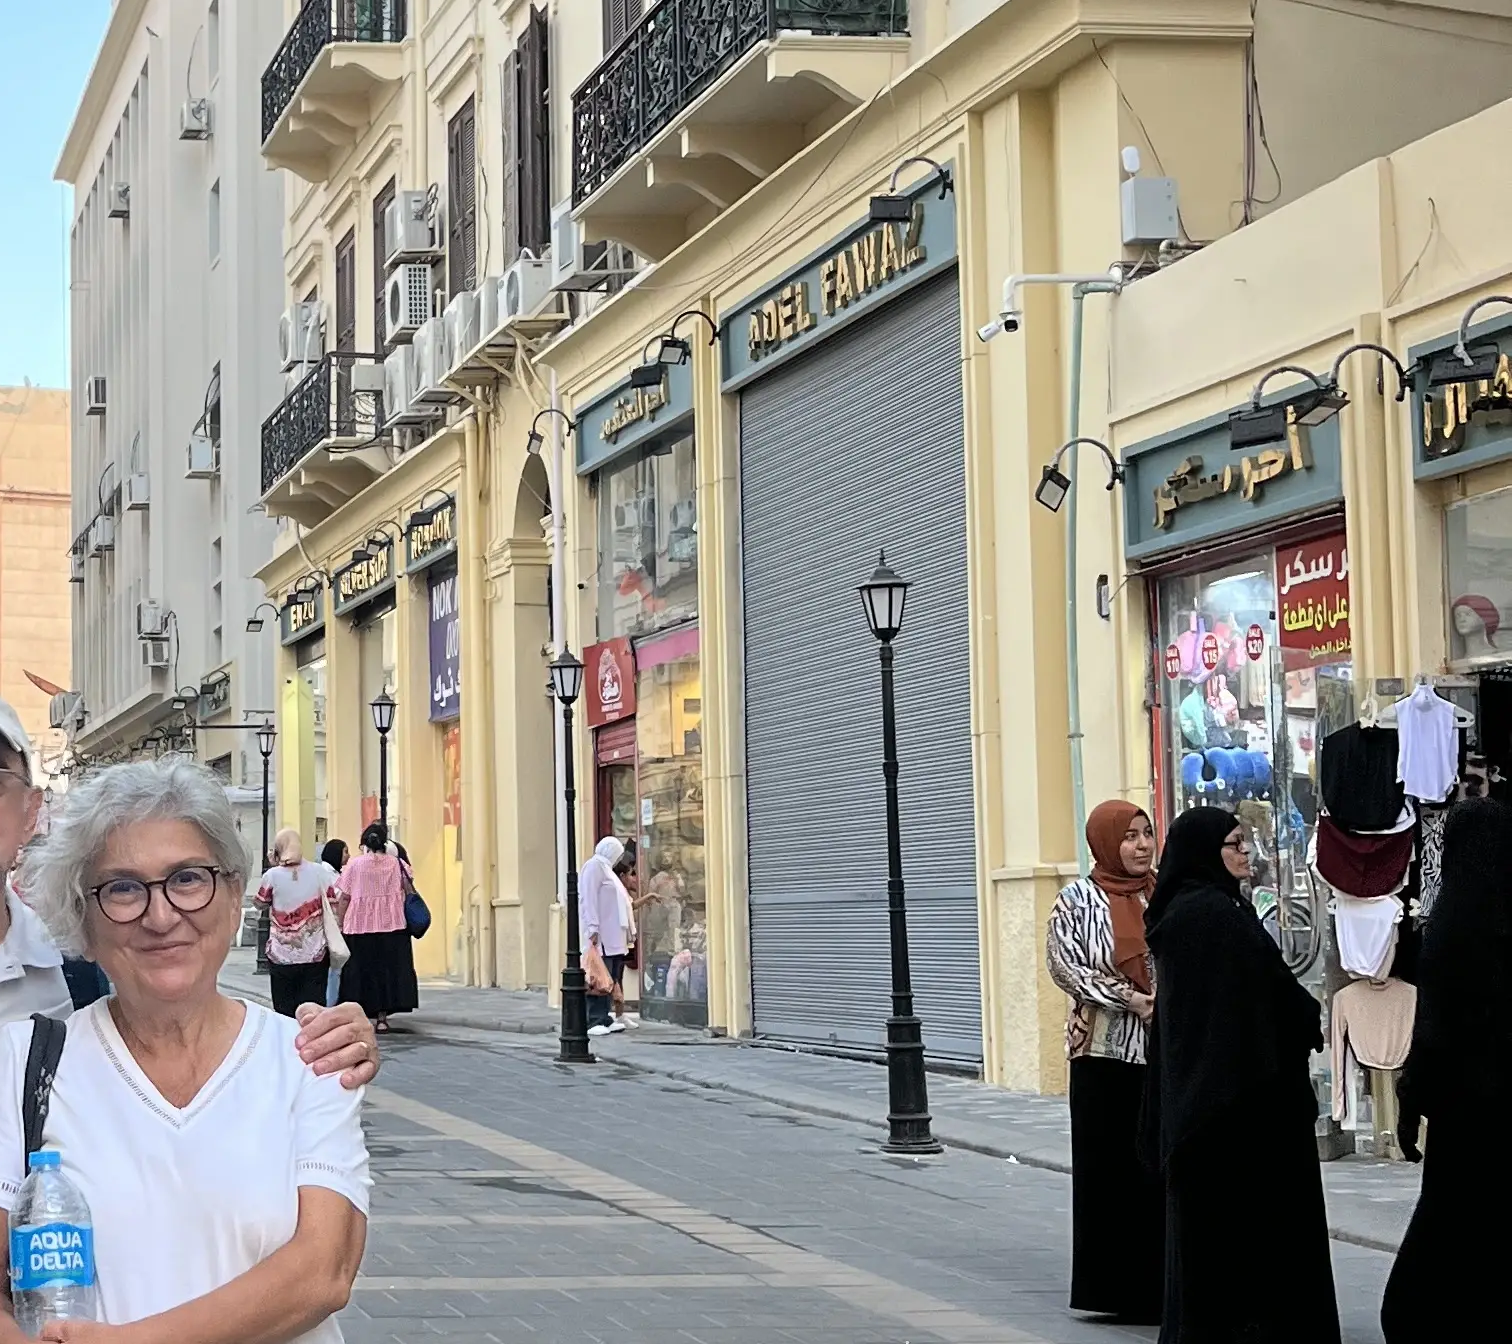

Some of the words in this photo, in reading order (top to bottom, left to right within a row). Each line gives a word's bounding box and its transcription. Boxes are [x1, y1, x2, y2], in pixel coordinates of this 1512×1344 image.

[748, 281, 811, 355] ADEL
[1280, 550, 1333, 594] سكر
[432, 577, 454, 622] NOK
[1283, 598, 1314, 631] قطعة
[29, 1231, 83, 1250] AQUA
[30, 1251, 85, 1271] DELTA
